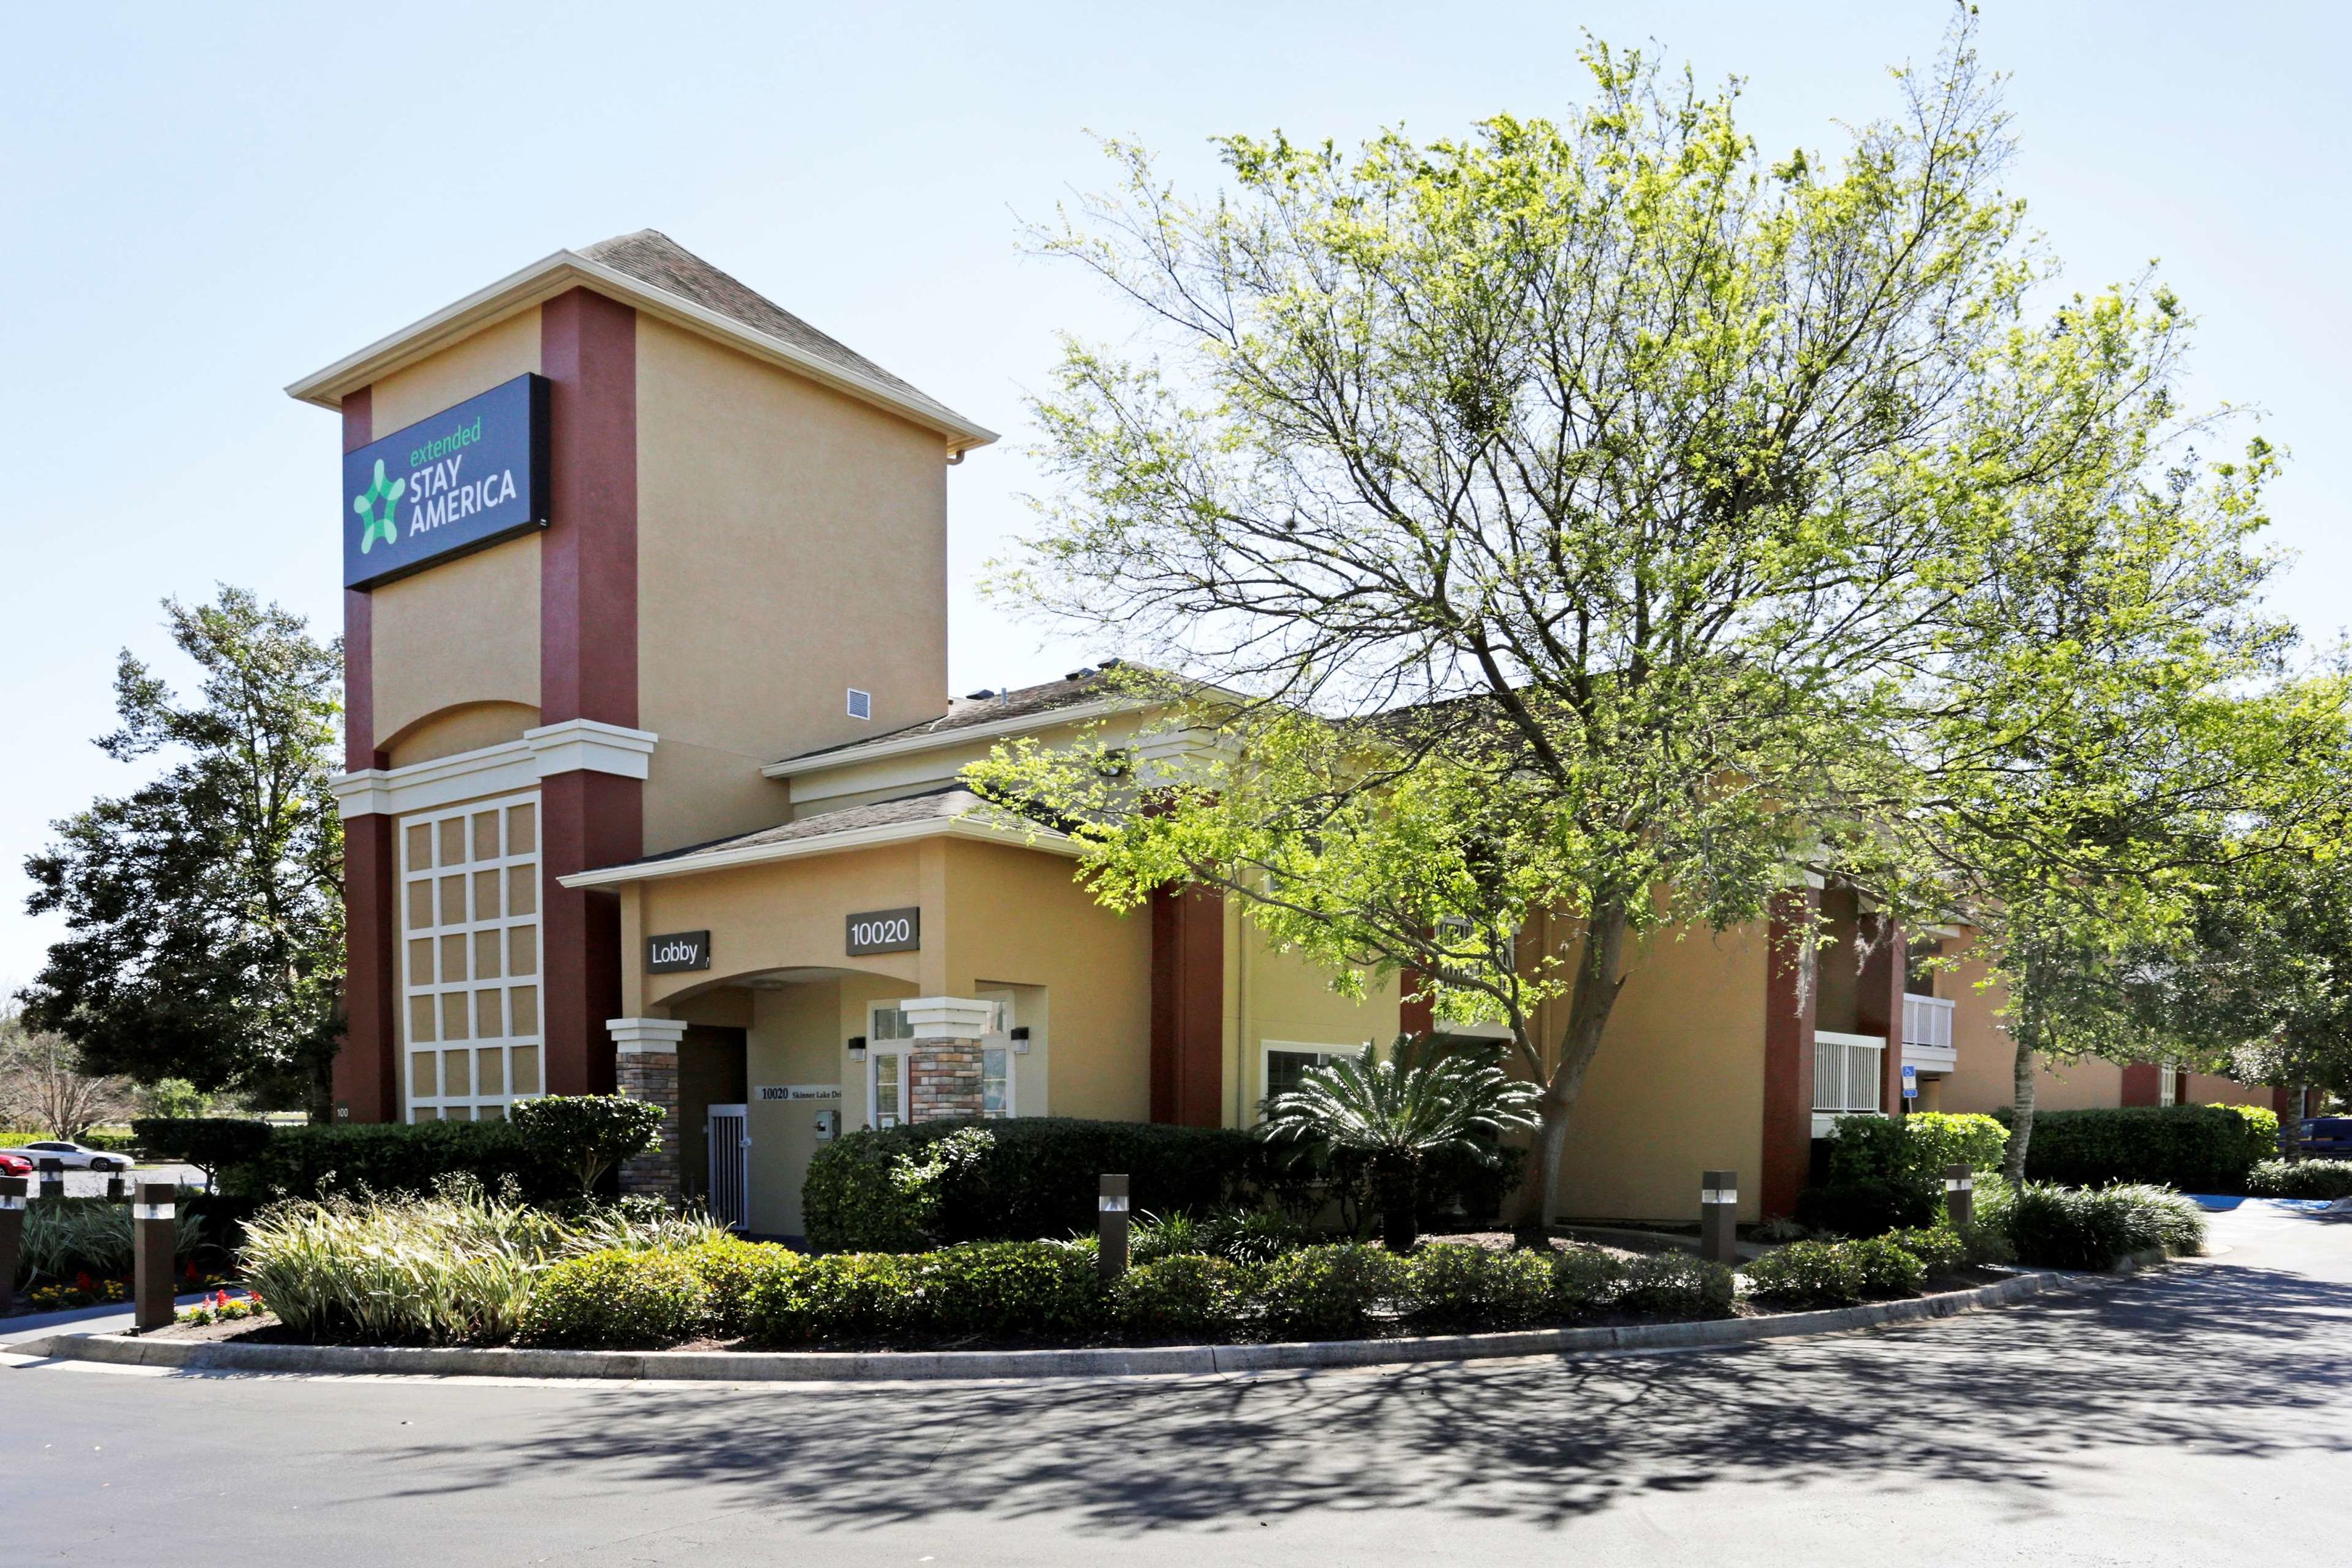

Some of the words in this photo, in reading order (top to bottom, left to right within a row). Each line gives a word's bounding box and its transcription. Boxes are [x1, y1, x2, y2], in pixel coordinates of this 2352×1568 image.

[409, 416, 481, 467] extended
[409, 454, 462, 503] STAY
[409, 469, 517, 537] AMERICA
[851, 918, 910, 945] 10020
[652, 940, 698, 965] Lobby
[762, 1087, 788, 1099] 10020
[337, 1108, 348, 1117] 100
